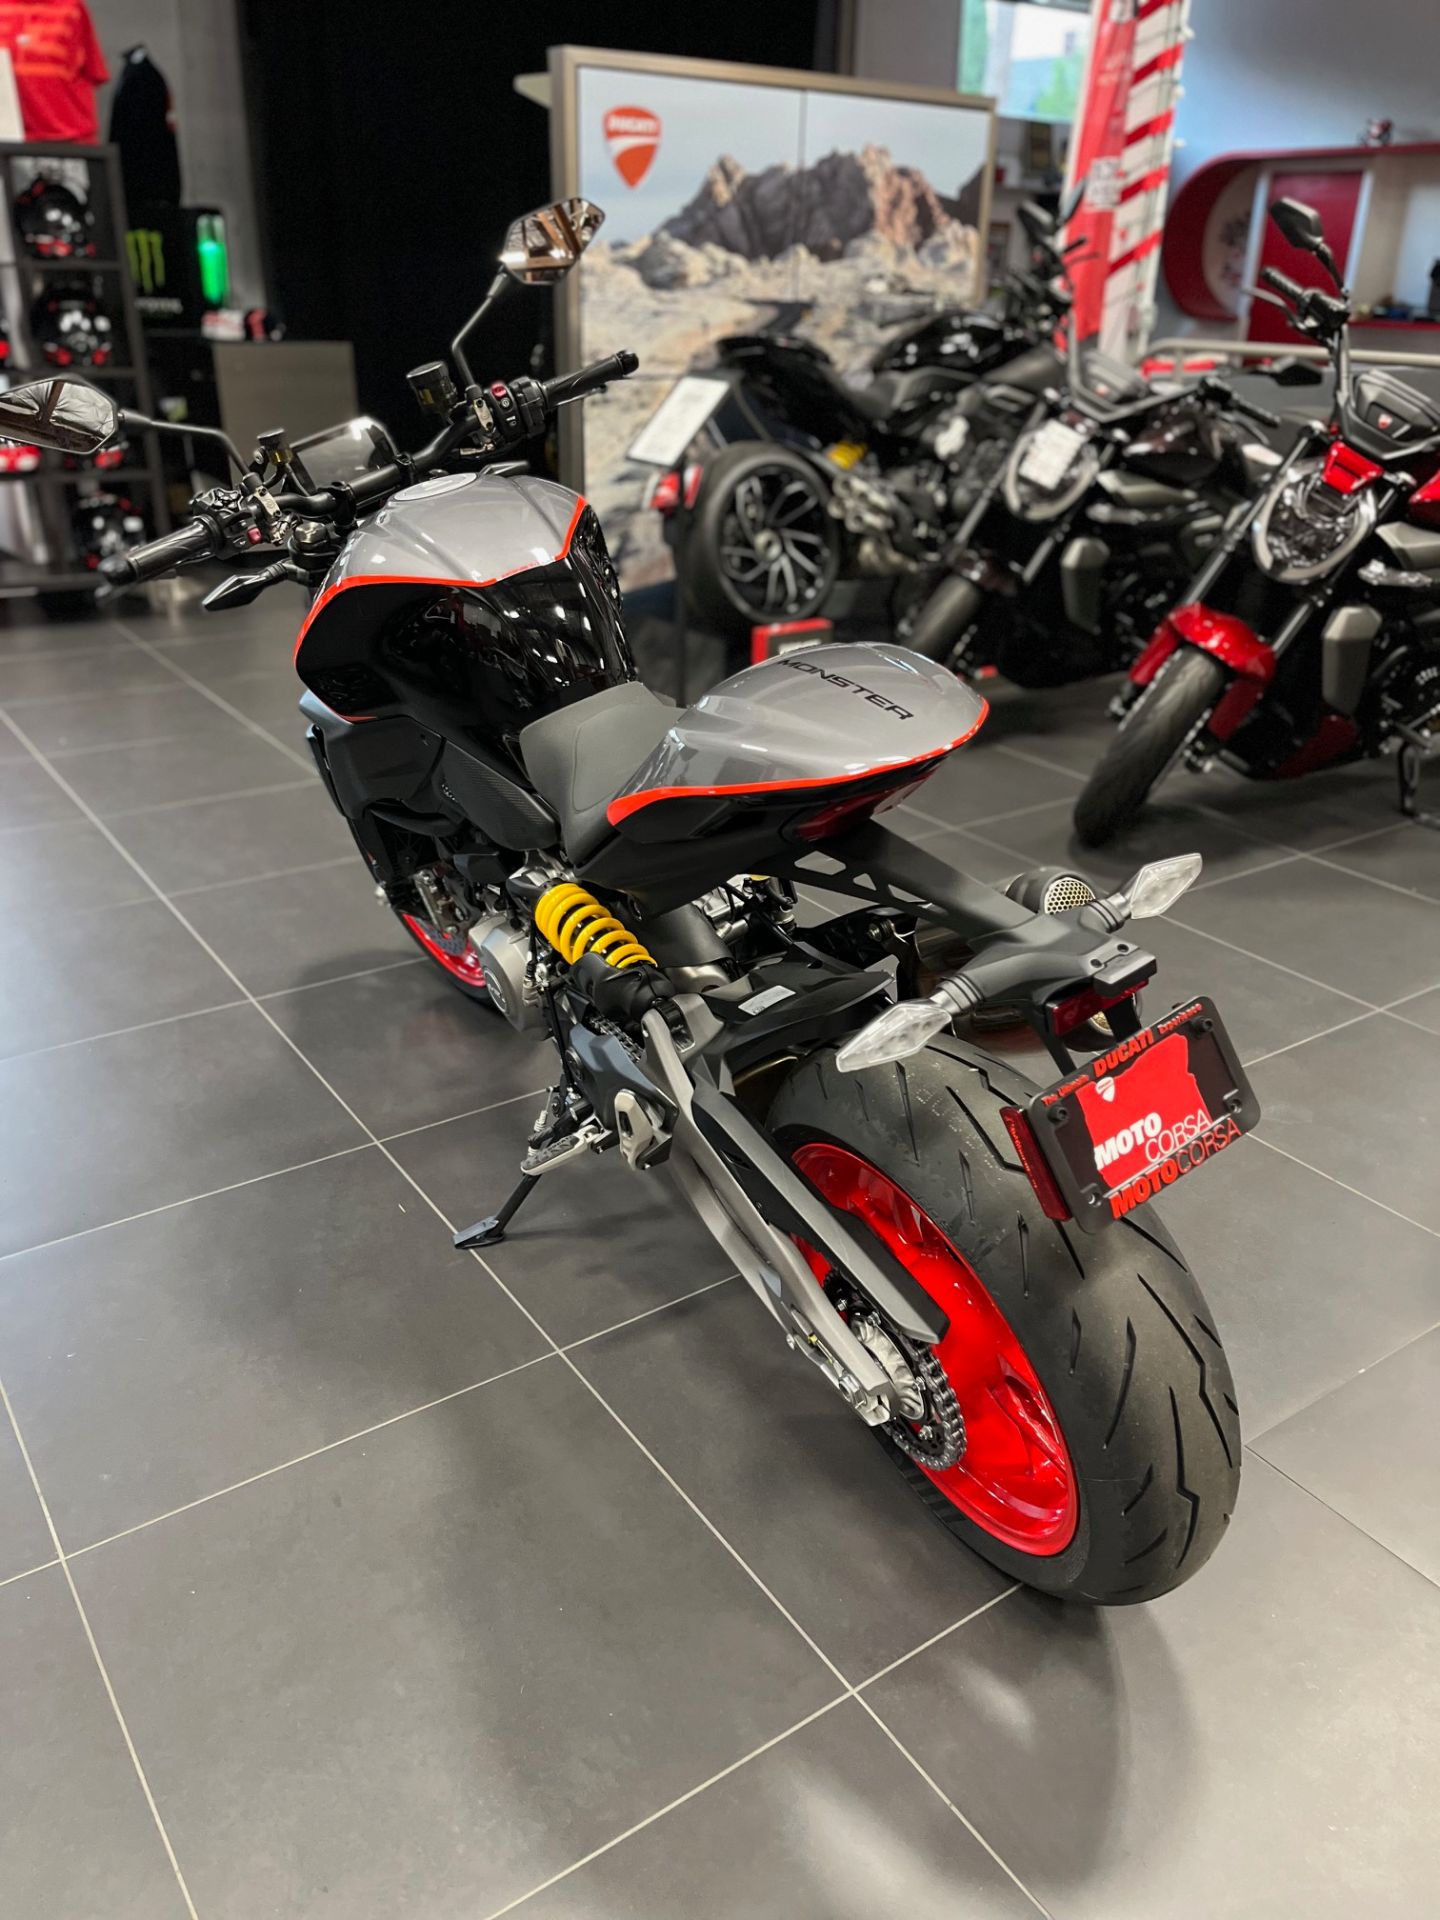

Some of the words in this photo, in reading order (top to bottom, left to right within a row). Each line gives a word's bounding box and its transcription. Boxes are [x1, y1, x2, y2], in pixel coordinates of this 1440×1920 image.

[778, 659, 914, 720] MONSTER
[1093, 1029, 1154, 1077] DUCATI
[1094, 1112, 1162, 1170] MOTO
[1145, 1109, 1212, 1162] CORSA
